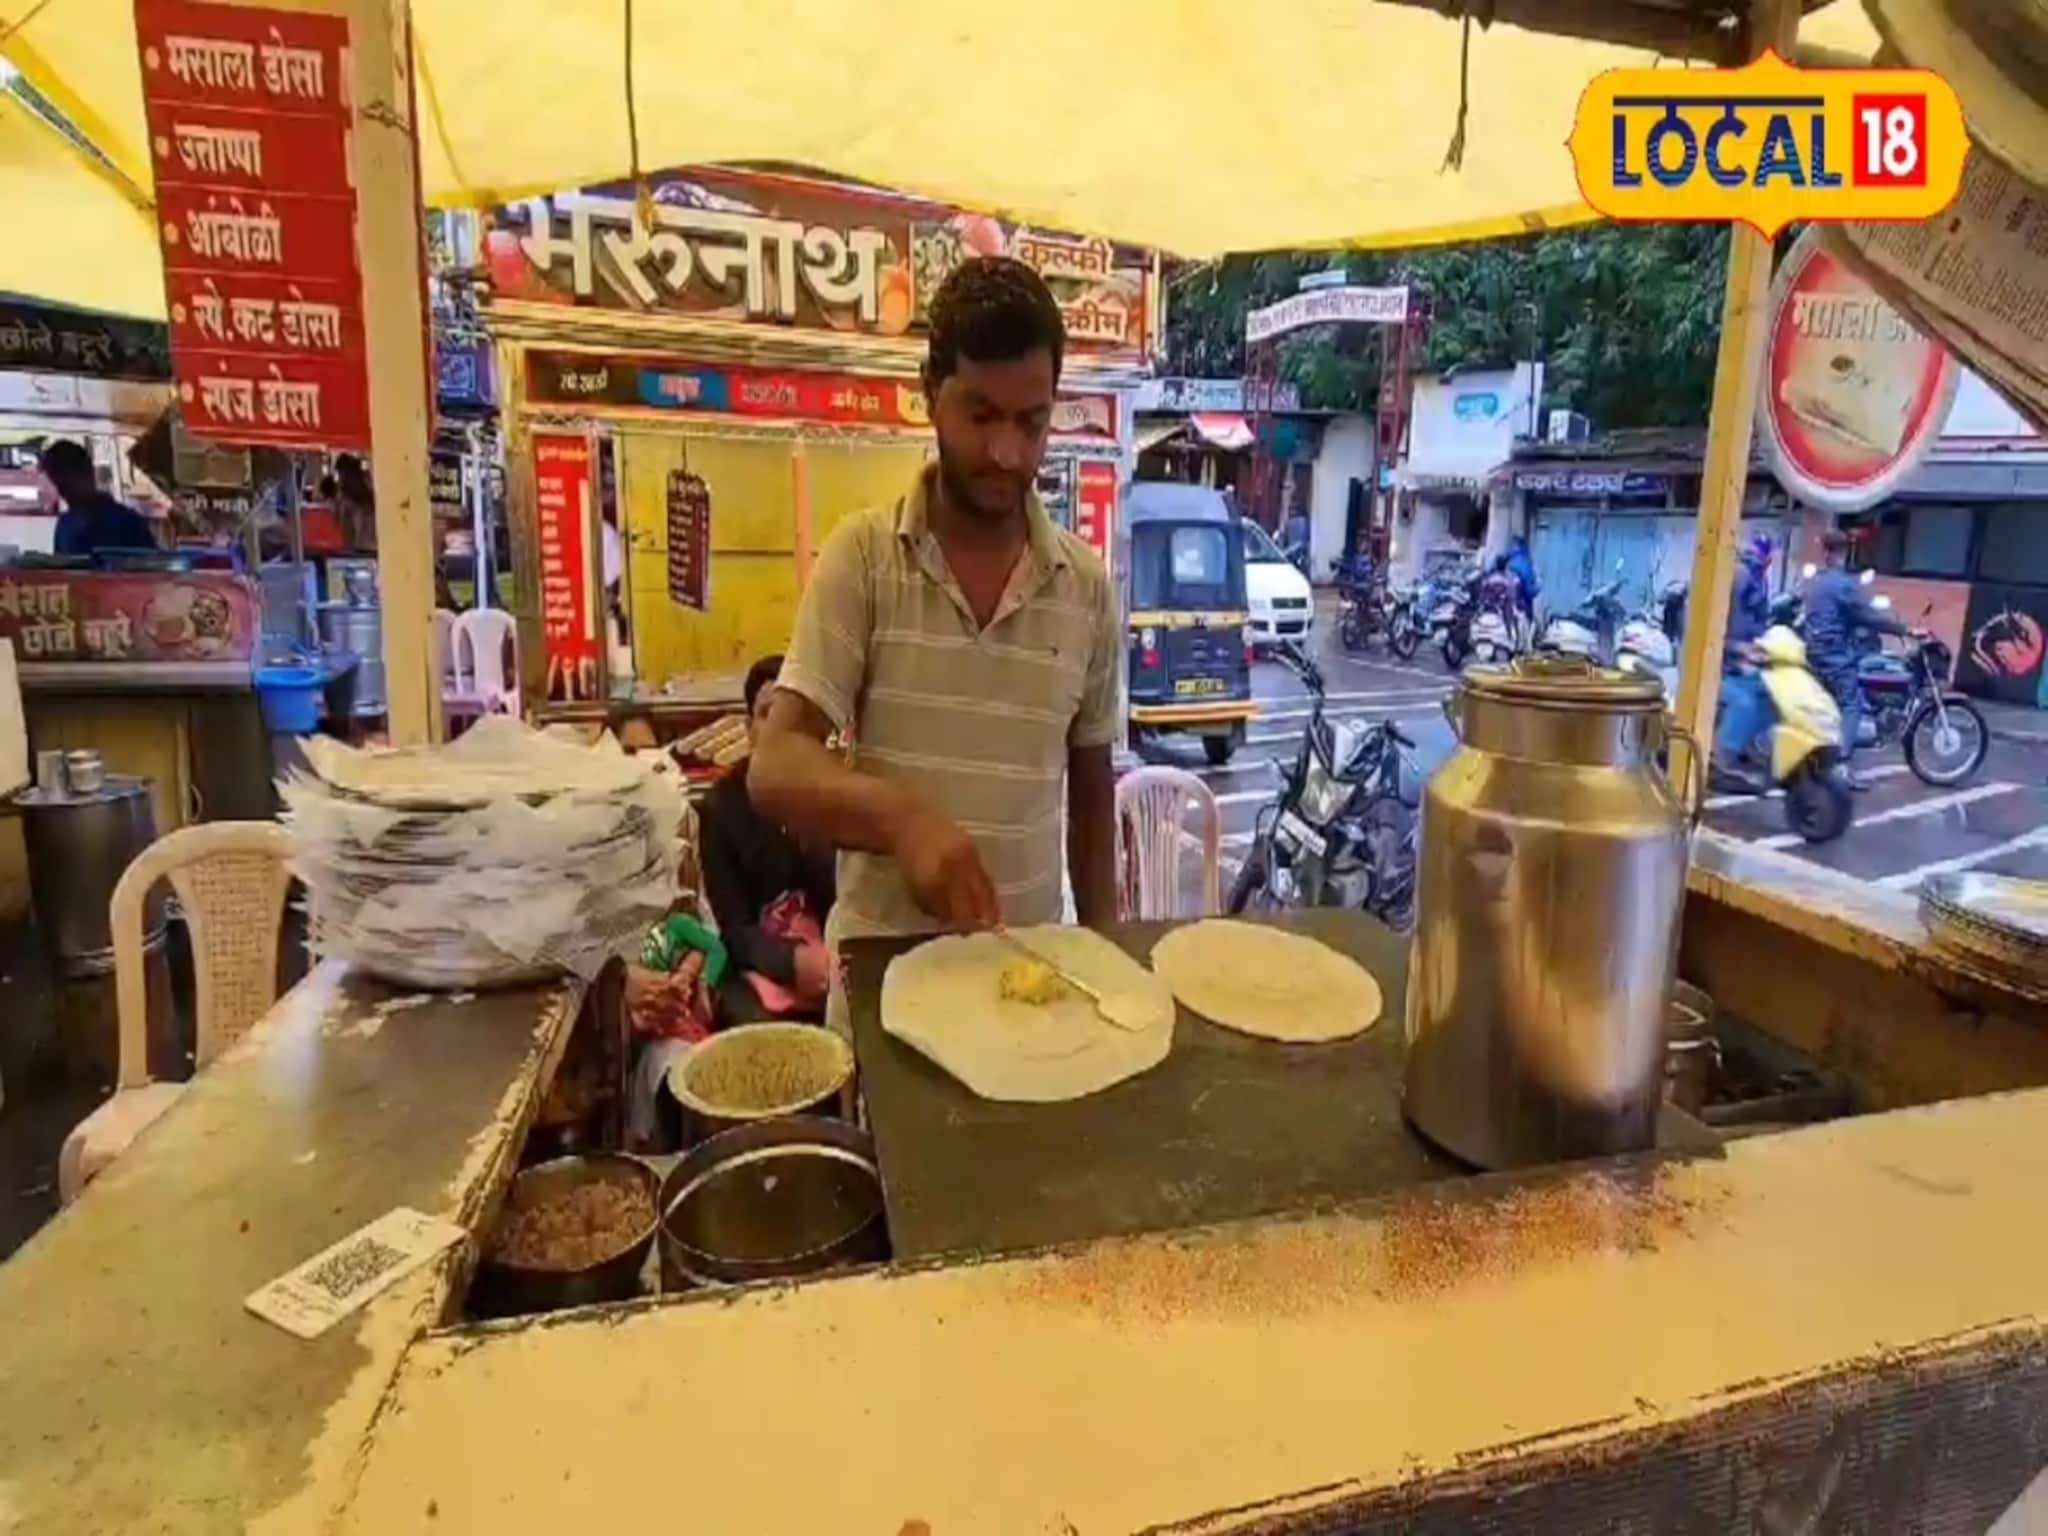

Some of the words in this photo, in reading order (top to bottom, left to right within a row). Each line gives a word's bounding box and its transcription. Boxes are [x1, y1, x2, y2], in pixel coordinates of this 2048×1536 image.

[166, 33, 256, 92] मसाला
[261, 27, 324, 98] डोसा
[278, 284, 340, 347] डोसा
[198, 360, 255, 423] स्पंज
[259, 363, 320, 427] डोसा
